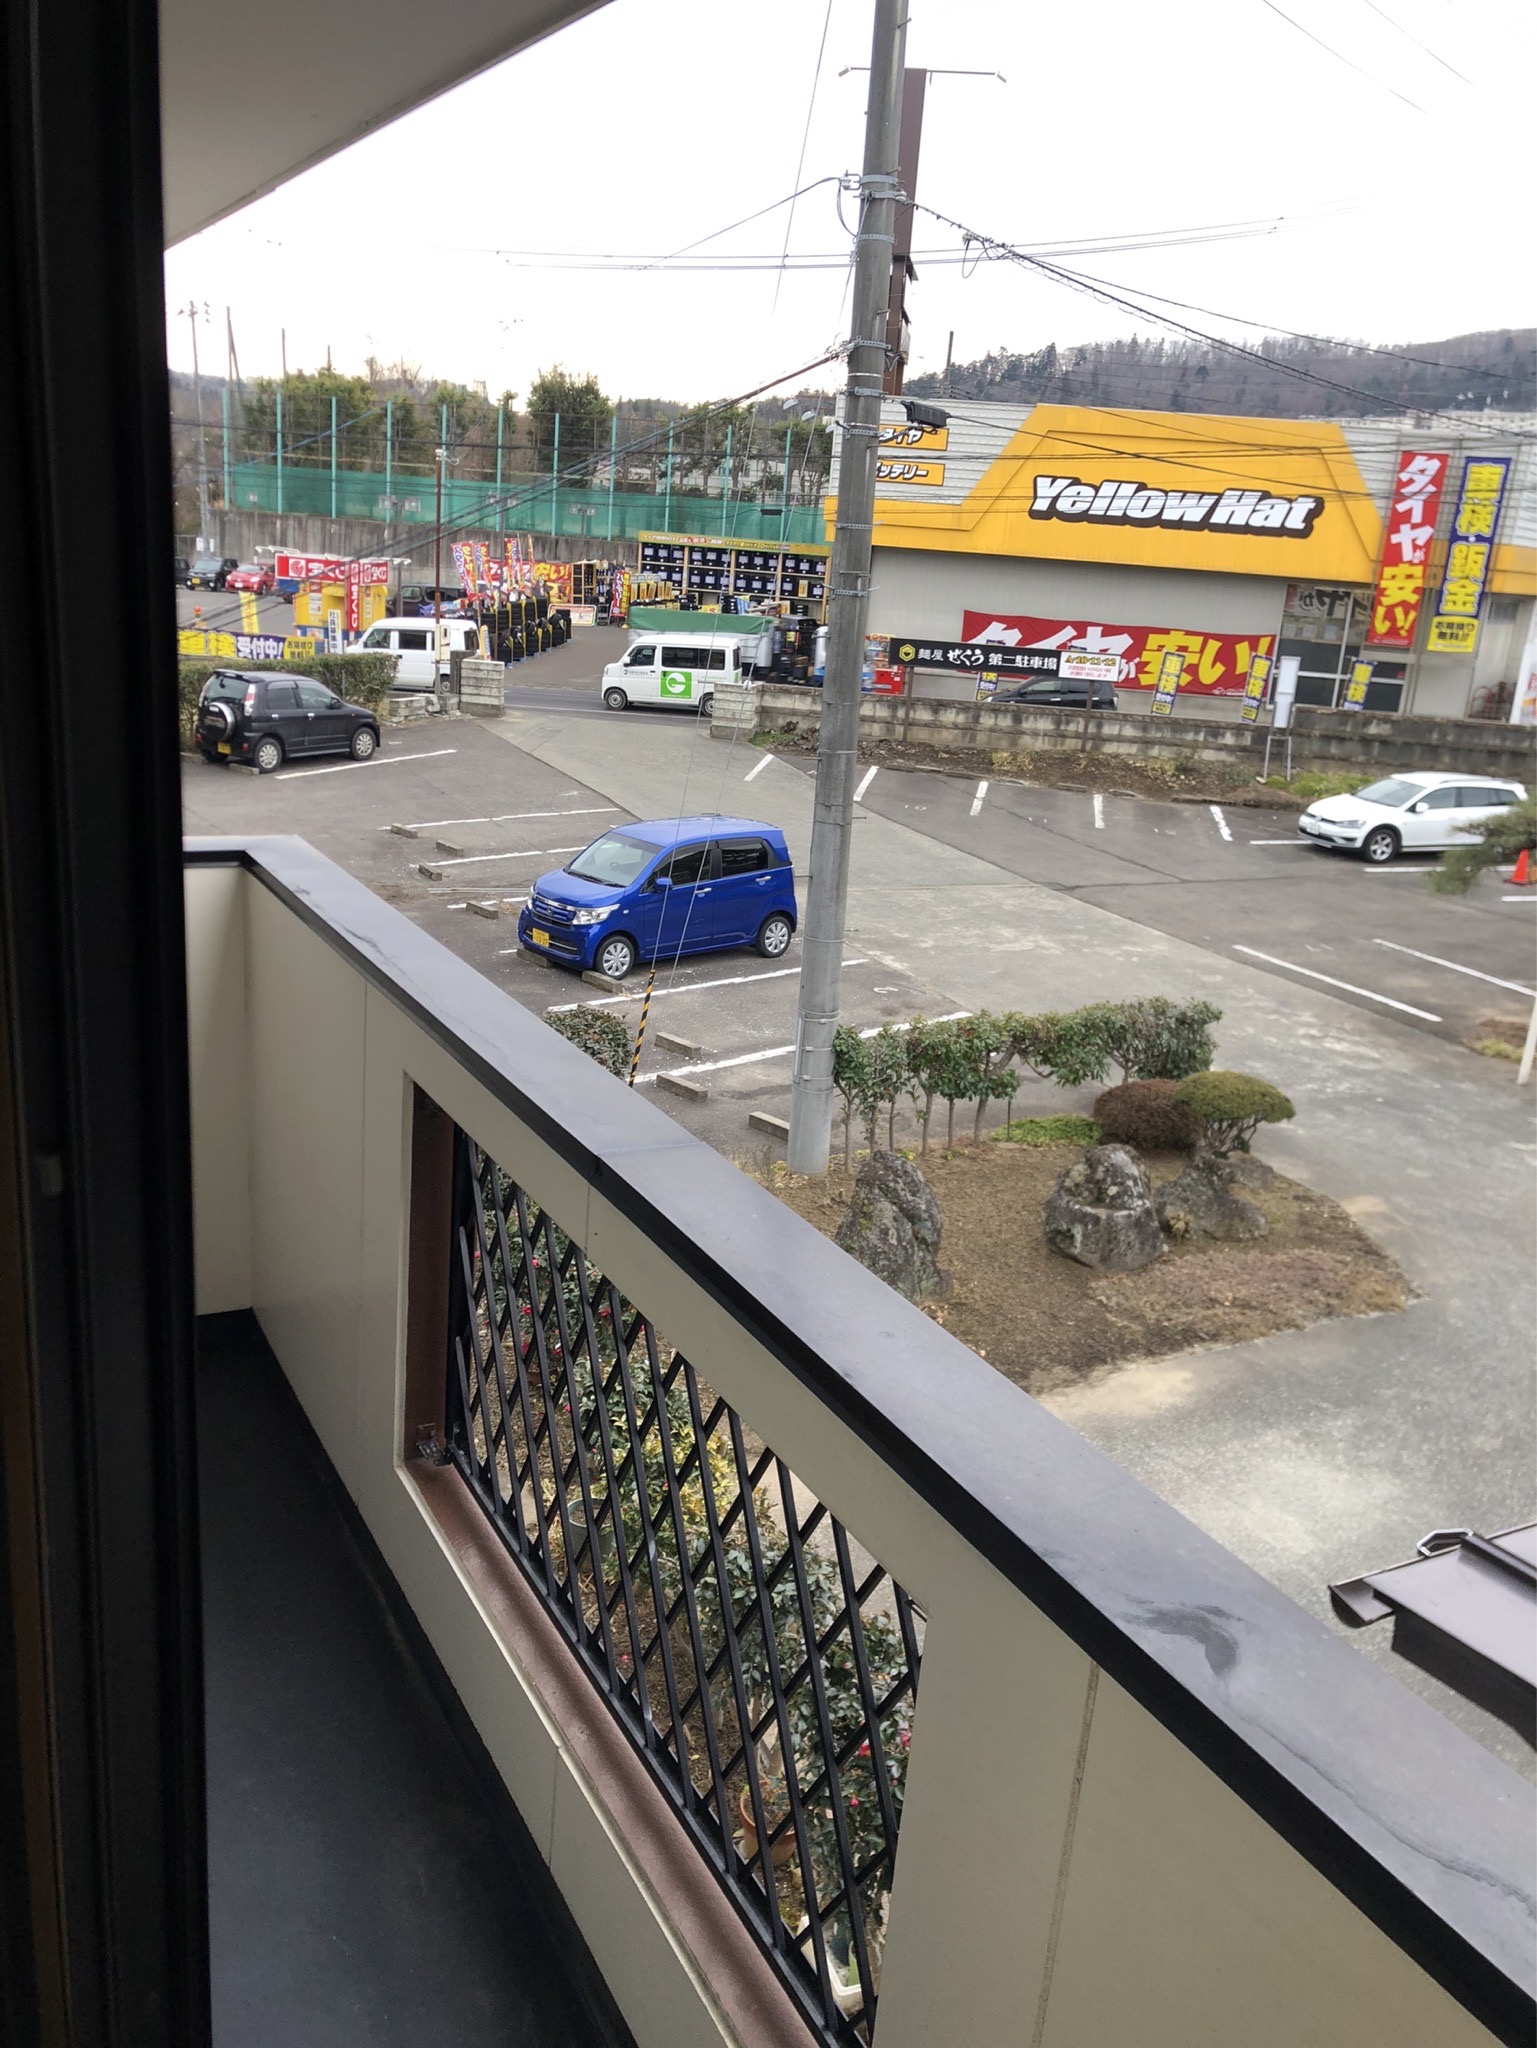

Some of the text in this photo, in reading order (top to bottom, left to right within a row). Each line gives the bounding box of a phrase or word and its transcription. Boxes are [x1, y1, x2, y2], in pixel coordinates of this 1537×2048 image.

[878, 427, 924, 445] タイヤ
[875, 462, 929, 480] ッテリー
[947, 648, 985, 667] ぜくう
[988, 653, 1058, 671] 第二駐車場
